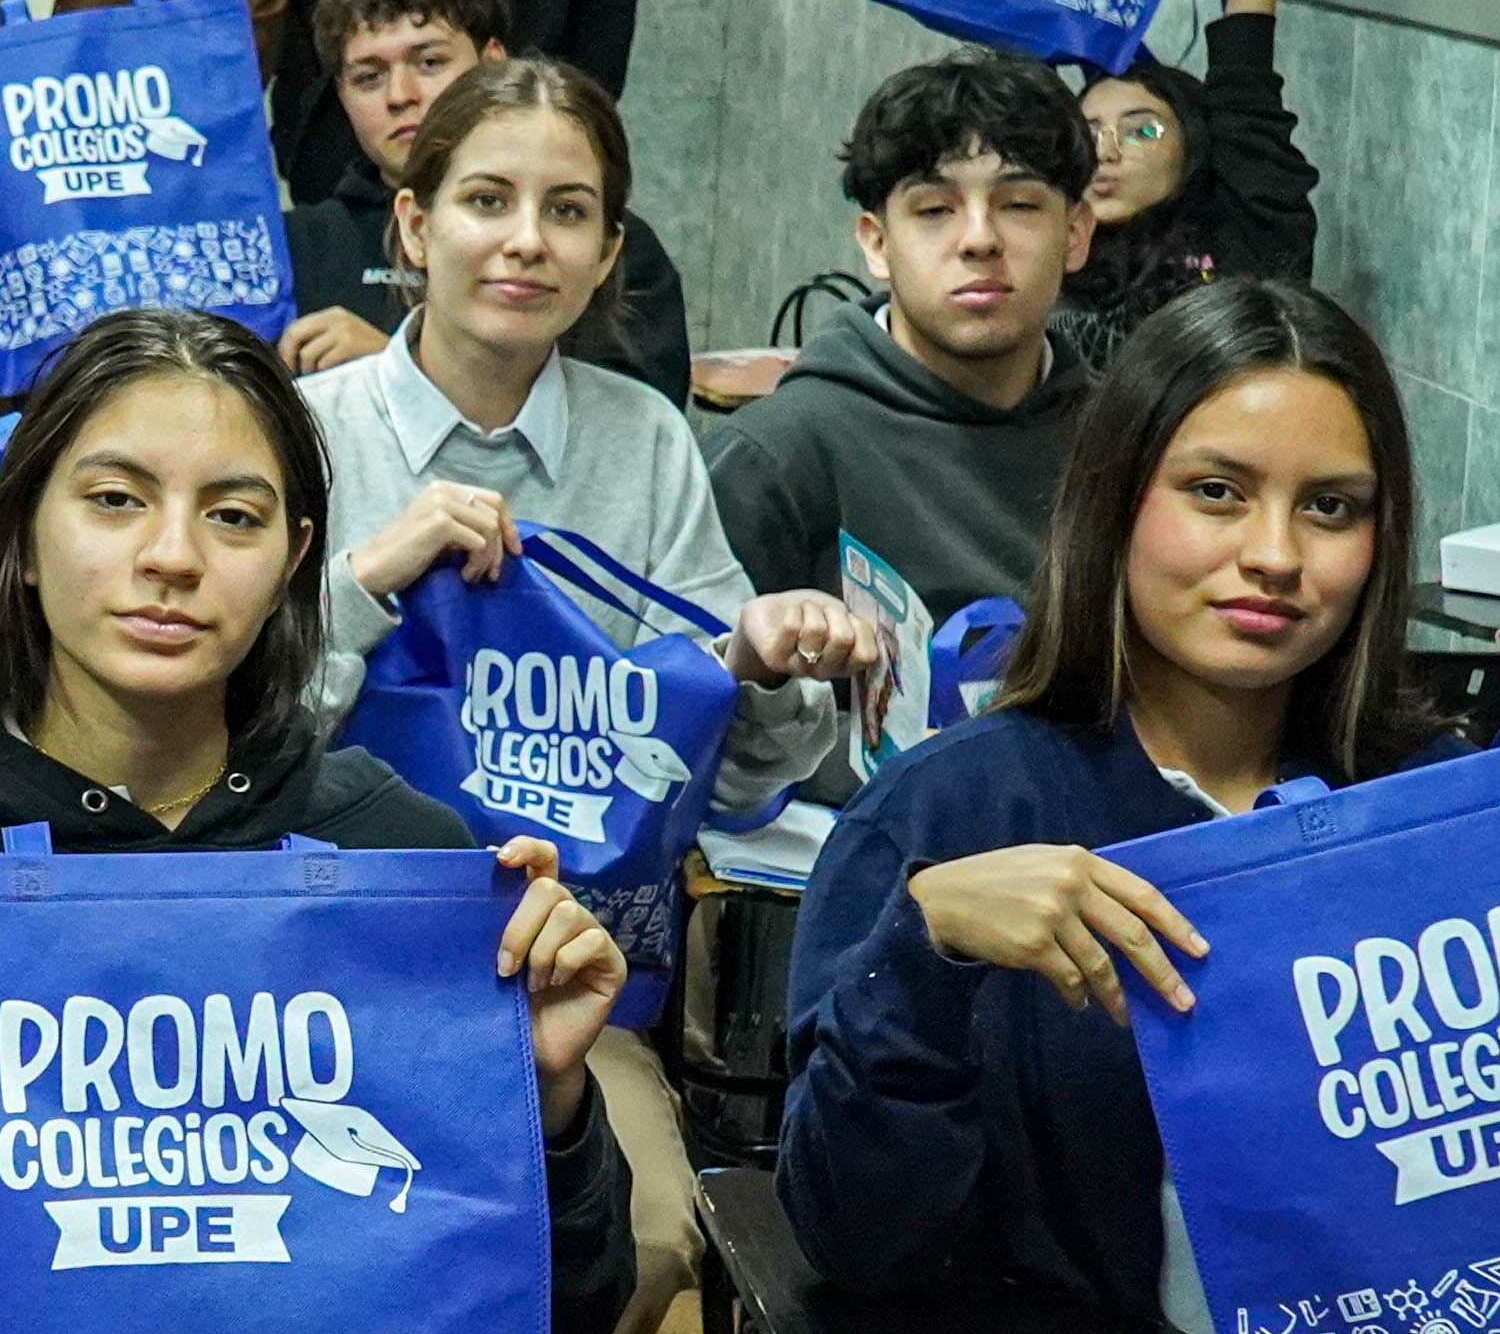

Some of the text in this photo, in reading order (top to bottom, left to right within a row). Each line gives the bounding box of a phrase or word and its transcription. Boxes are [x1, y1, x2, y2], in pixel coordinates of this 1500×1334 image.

[2, 66, 171, 136] PROMO
[65, 170, 126, 195] UPE
[469, 648, 659, 737] ROMO
[486, 778, 574, 829] UPE
[99, 1205, 236, 1254] UPE
